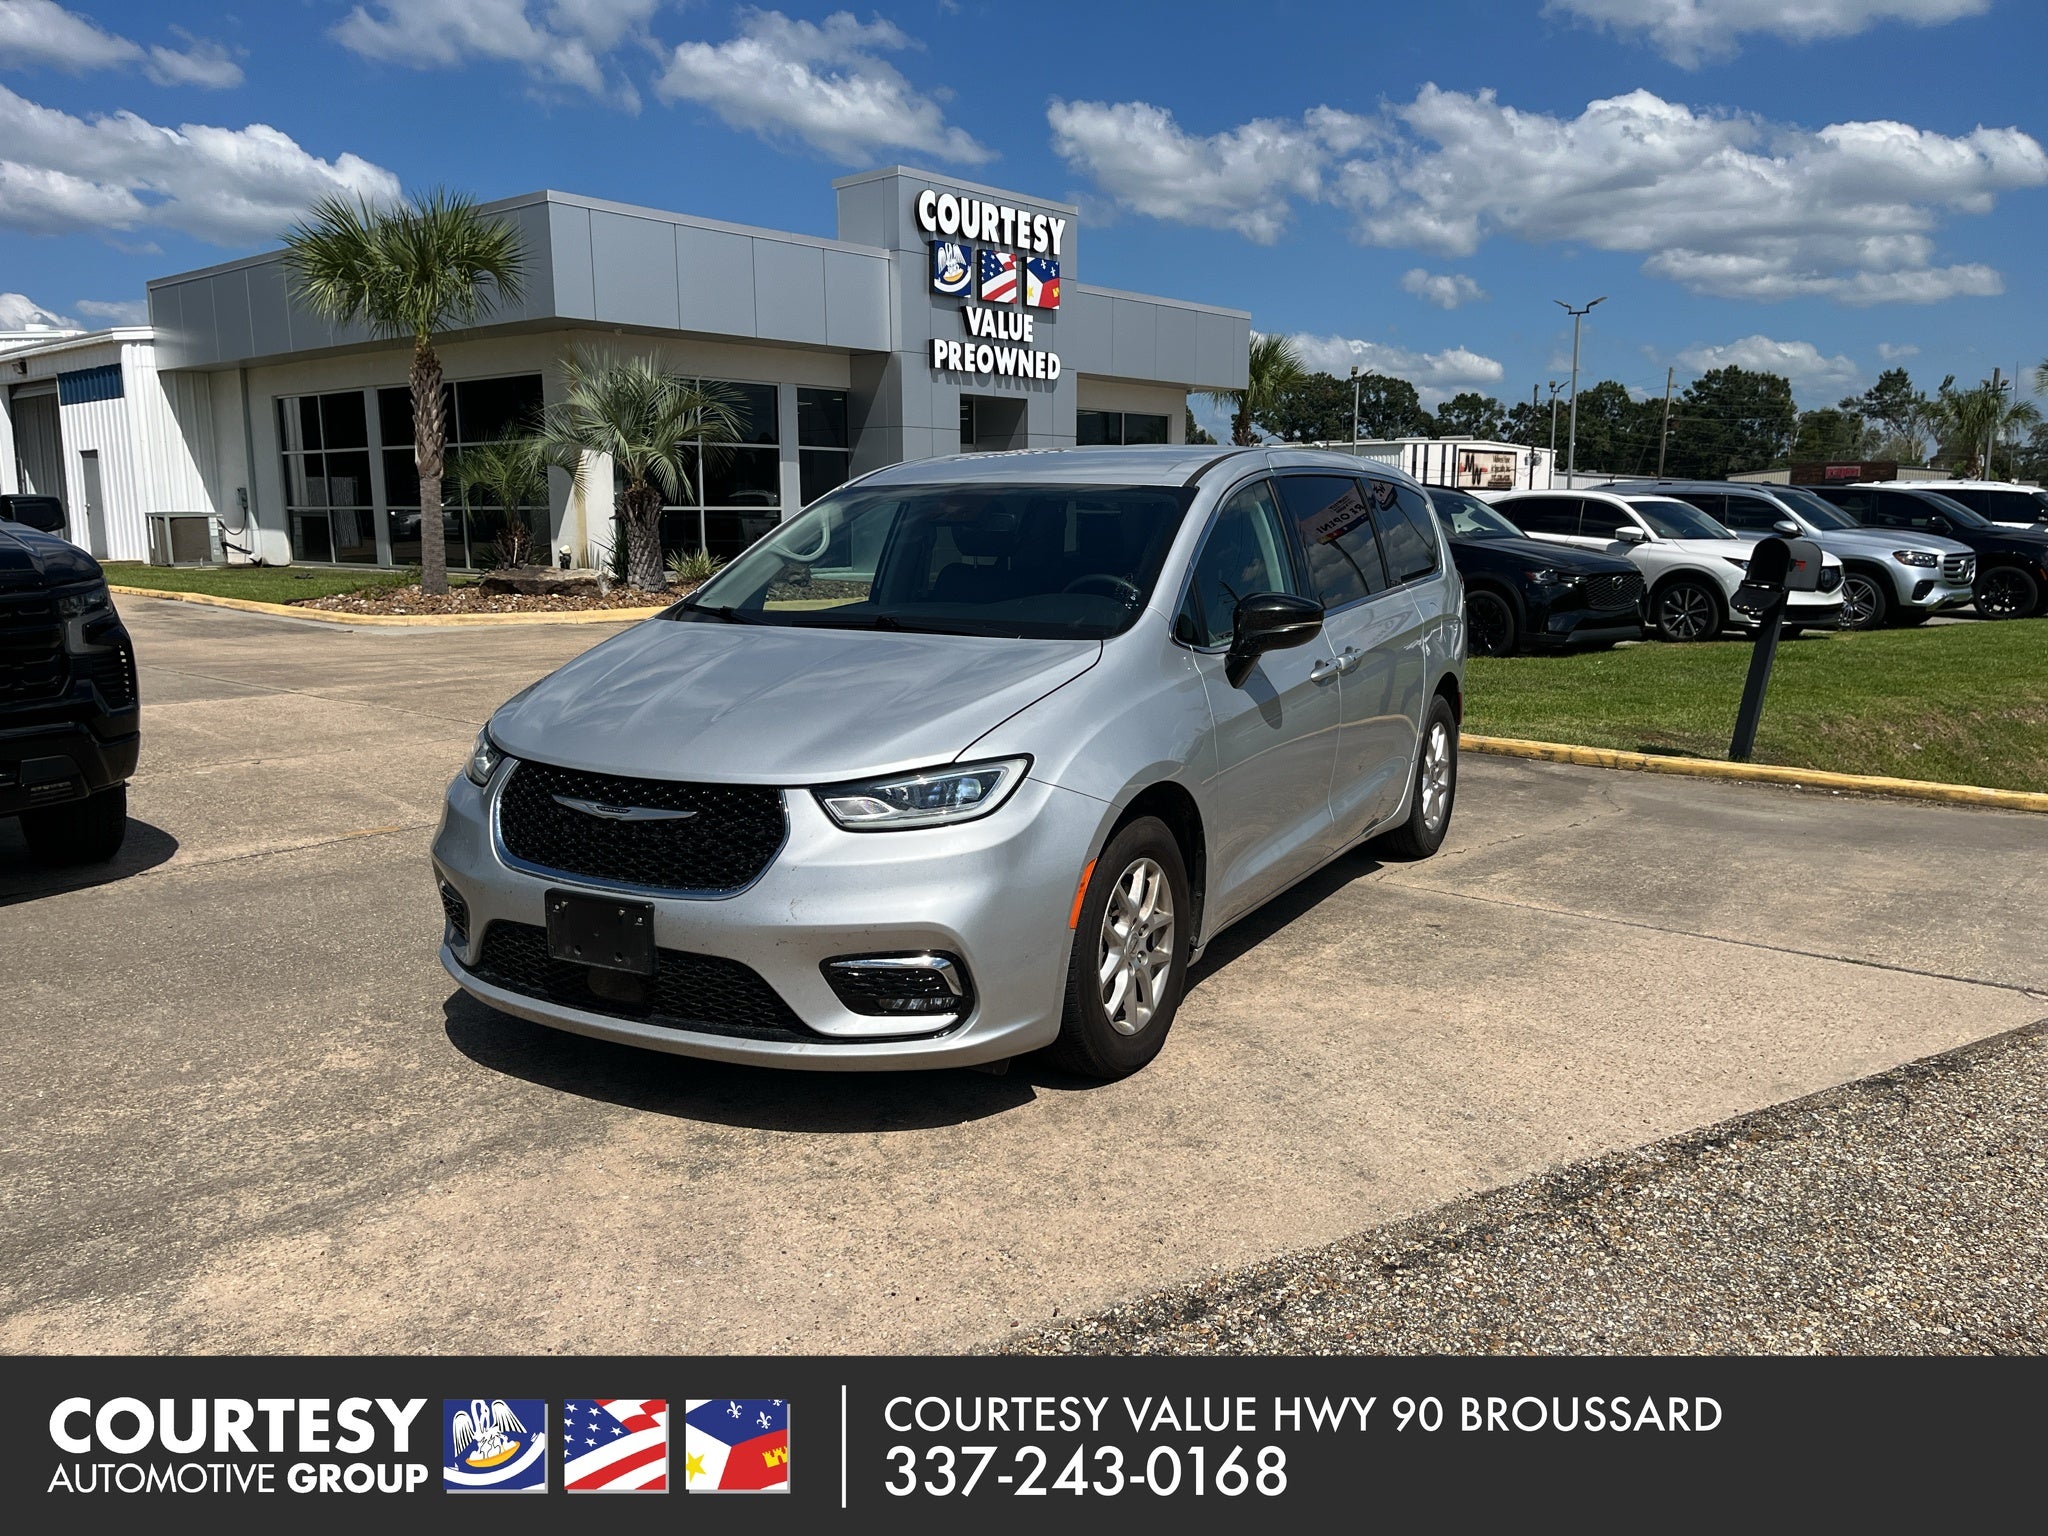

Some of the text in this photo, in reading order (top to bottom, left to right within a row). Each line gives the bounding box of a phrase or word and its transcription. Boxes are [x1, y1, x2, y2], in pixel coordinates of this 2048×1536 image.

[917, 189, 1066, 256] COURTESY
[964, 306, 1034, 343] VALUE
[933, 339, 1061, 381] PREOWNED
